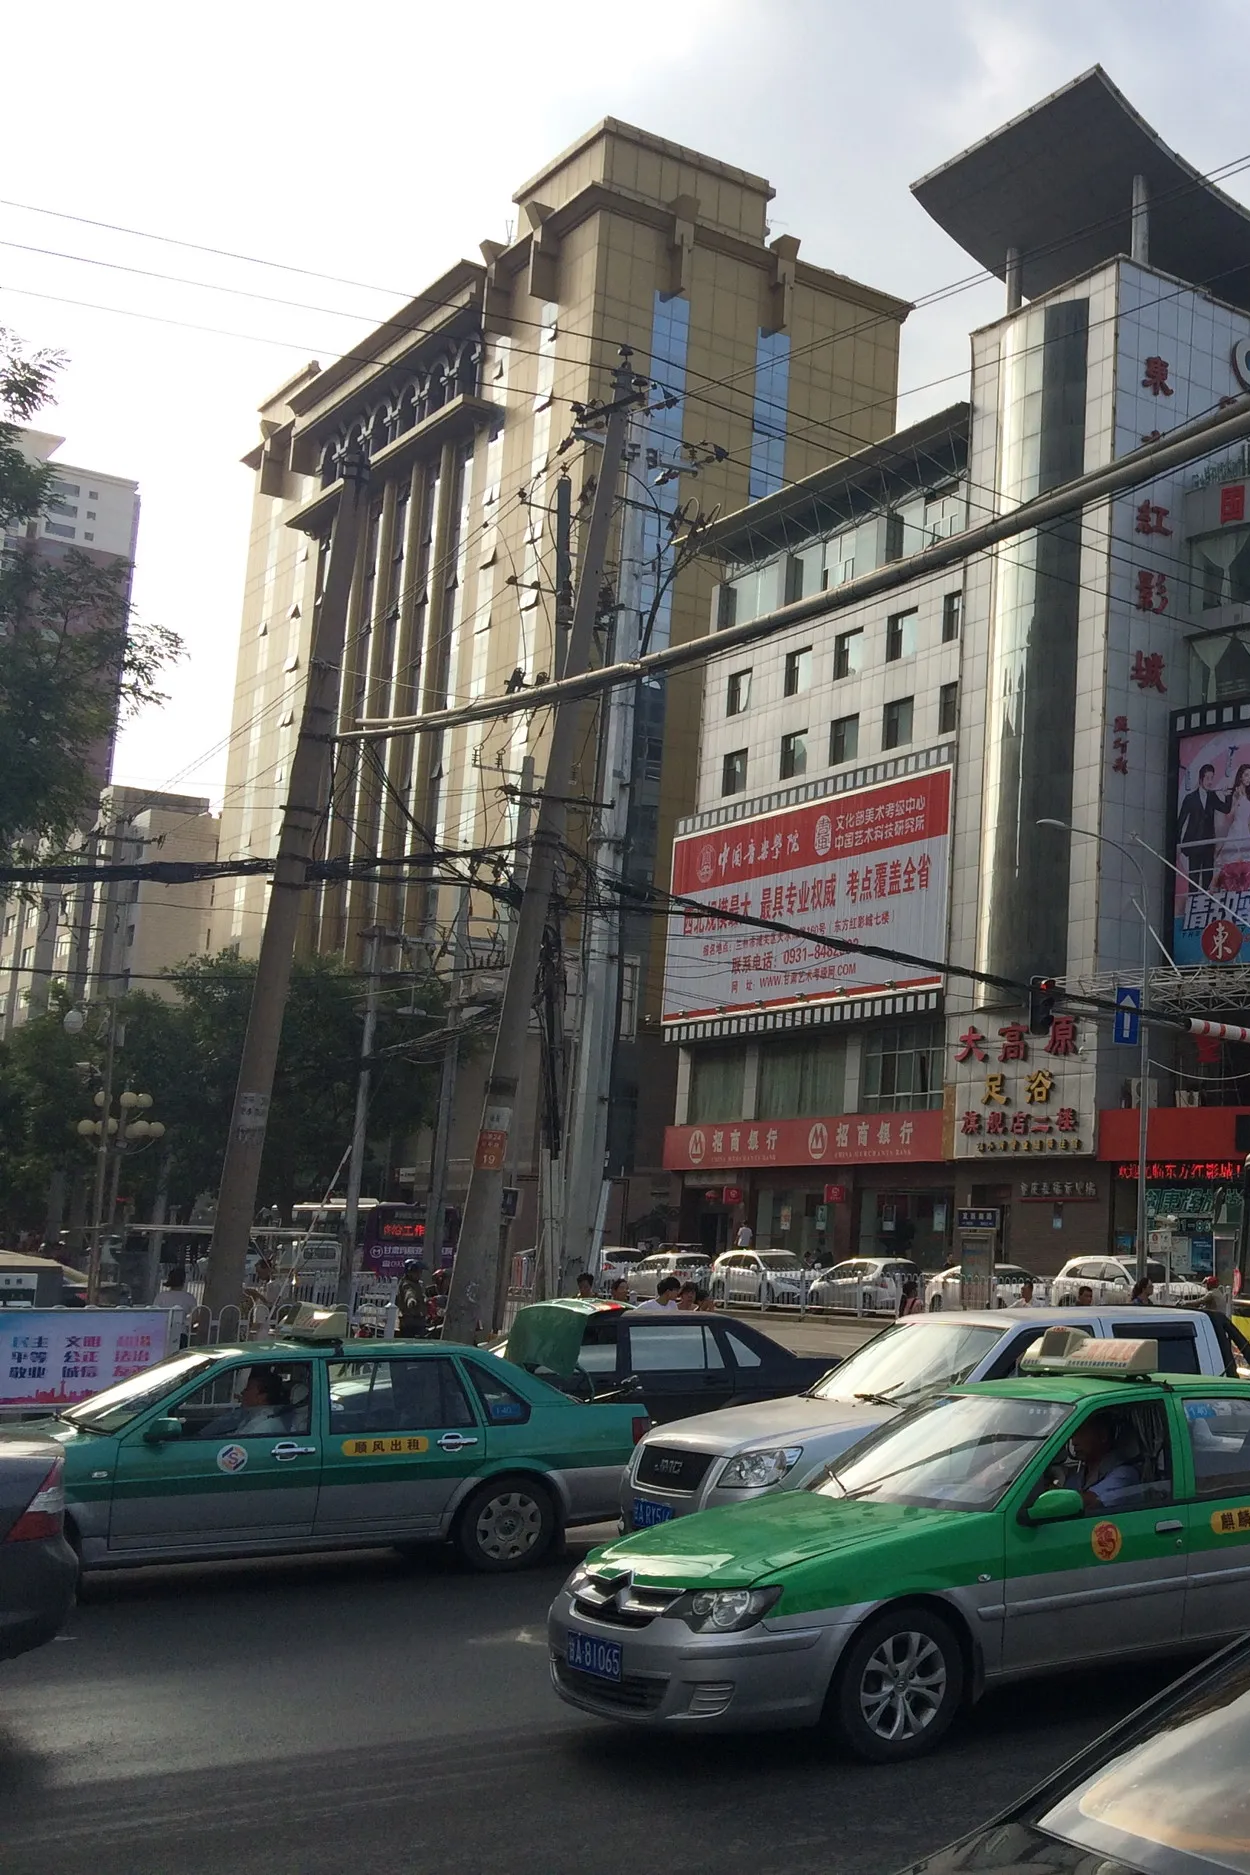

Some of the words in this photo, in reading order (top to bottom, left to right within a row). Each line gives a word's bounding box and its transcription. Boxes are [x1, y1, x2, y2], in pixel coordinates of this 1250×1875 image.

[836, 795, 926, 832] 文化部美术考级中心
[835, 814, 926, 850] 中国艺术科技研究所
[760, 873, 836, 919] 最具专业权威
[846, 853, 932, 904] 考点覆盖全省
[954, 1016, 1079, 1062] 大高原
[981, 1068, 1055, 1105] 足浴
[836, 1120, 913, 1148] 招商银行
[961, 1108, 1079, 1135] 旗舰店二楼
[713, 1128, 778, 1152] 招商银行
[12, 1336, 49, 1348] 民主
[65, 1336, 102, 1348] 文明
[11, 1351, 48, 1363] 平等
[63, 1350, 99, 1363] 公正
[113, 1350, 149, 1363] 法治
[9, 1365, 46, 1379] 敬业
[62, 1365, 98, 1378] 诚信
[354, 1438, 420, 1454] 顺风出租
